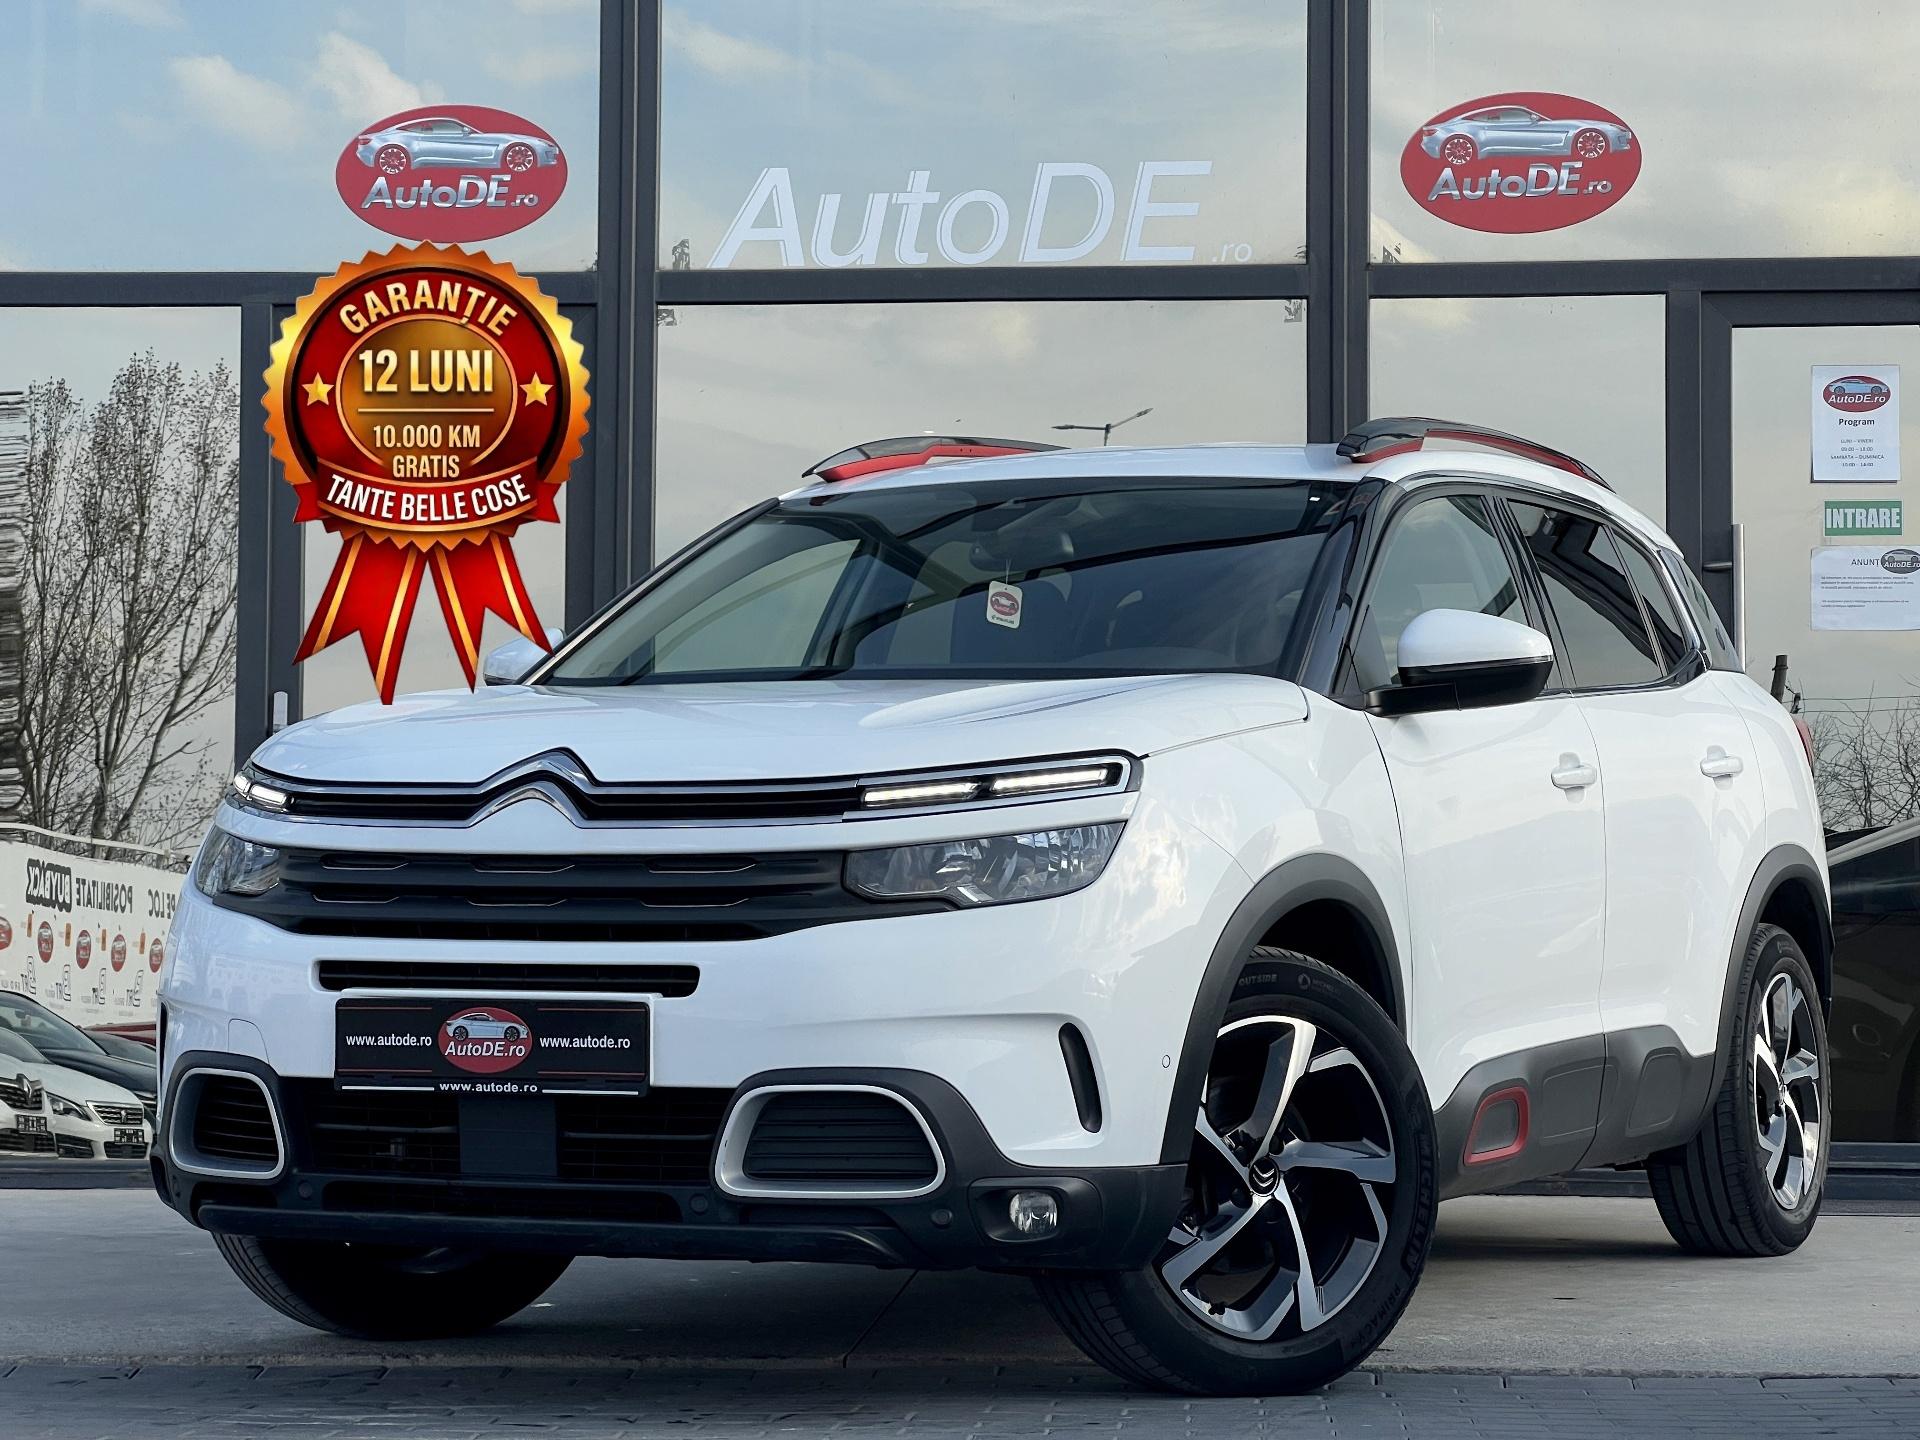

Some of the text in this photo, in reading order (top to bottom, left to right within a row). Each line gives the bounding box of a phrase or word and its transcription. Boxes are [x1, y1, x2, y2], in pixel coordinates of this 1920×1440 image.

[1828, 394, 1886, 404] AutoDE.ro
[1838, 418, 1875, 427] Program
[1825, 507, 1901, 529] INTRARE
[345, 1033, 631, 1057] www.autode.ro AutoDE.ro www.autode.ro
[439, 1081, 538, 1093] www.autode.ro
